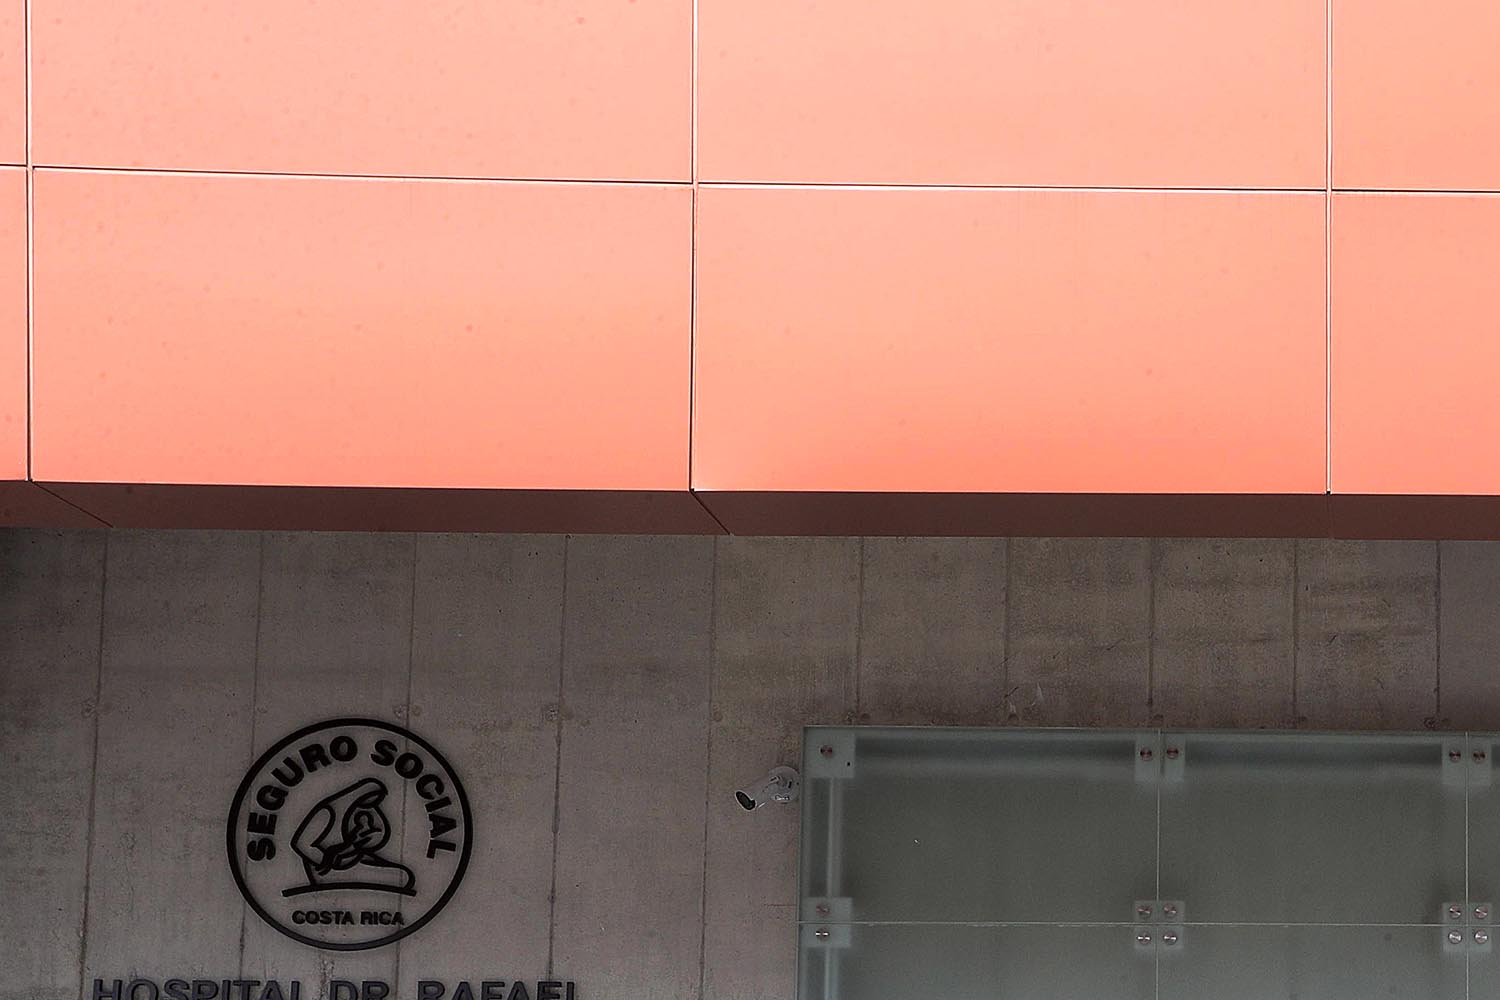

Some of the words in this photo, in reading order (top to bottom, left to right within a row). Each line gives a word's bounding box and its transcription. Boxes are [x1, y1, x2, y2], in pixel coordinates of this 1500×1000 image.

[247, 735, 358, 861] SEGURO
[370, 740, 457, 859] SOCIAL
[292, 910, 354, 925] COSTA
[360, 911, 405, 925] RICA
